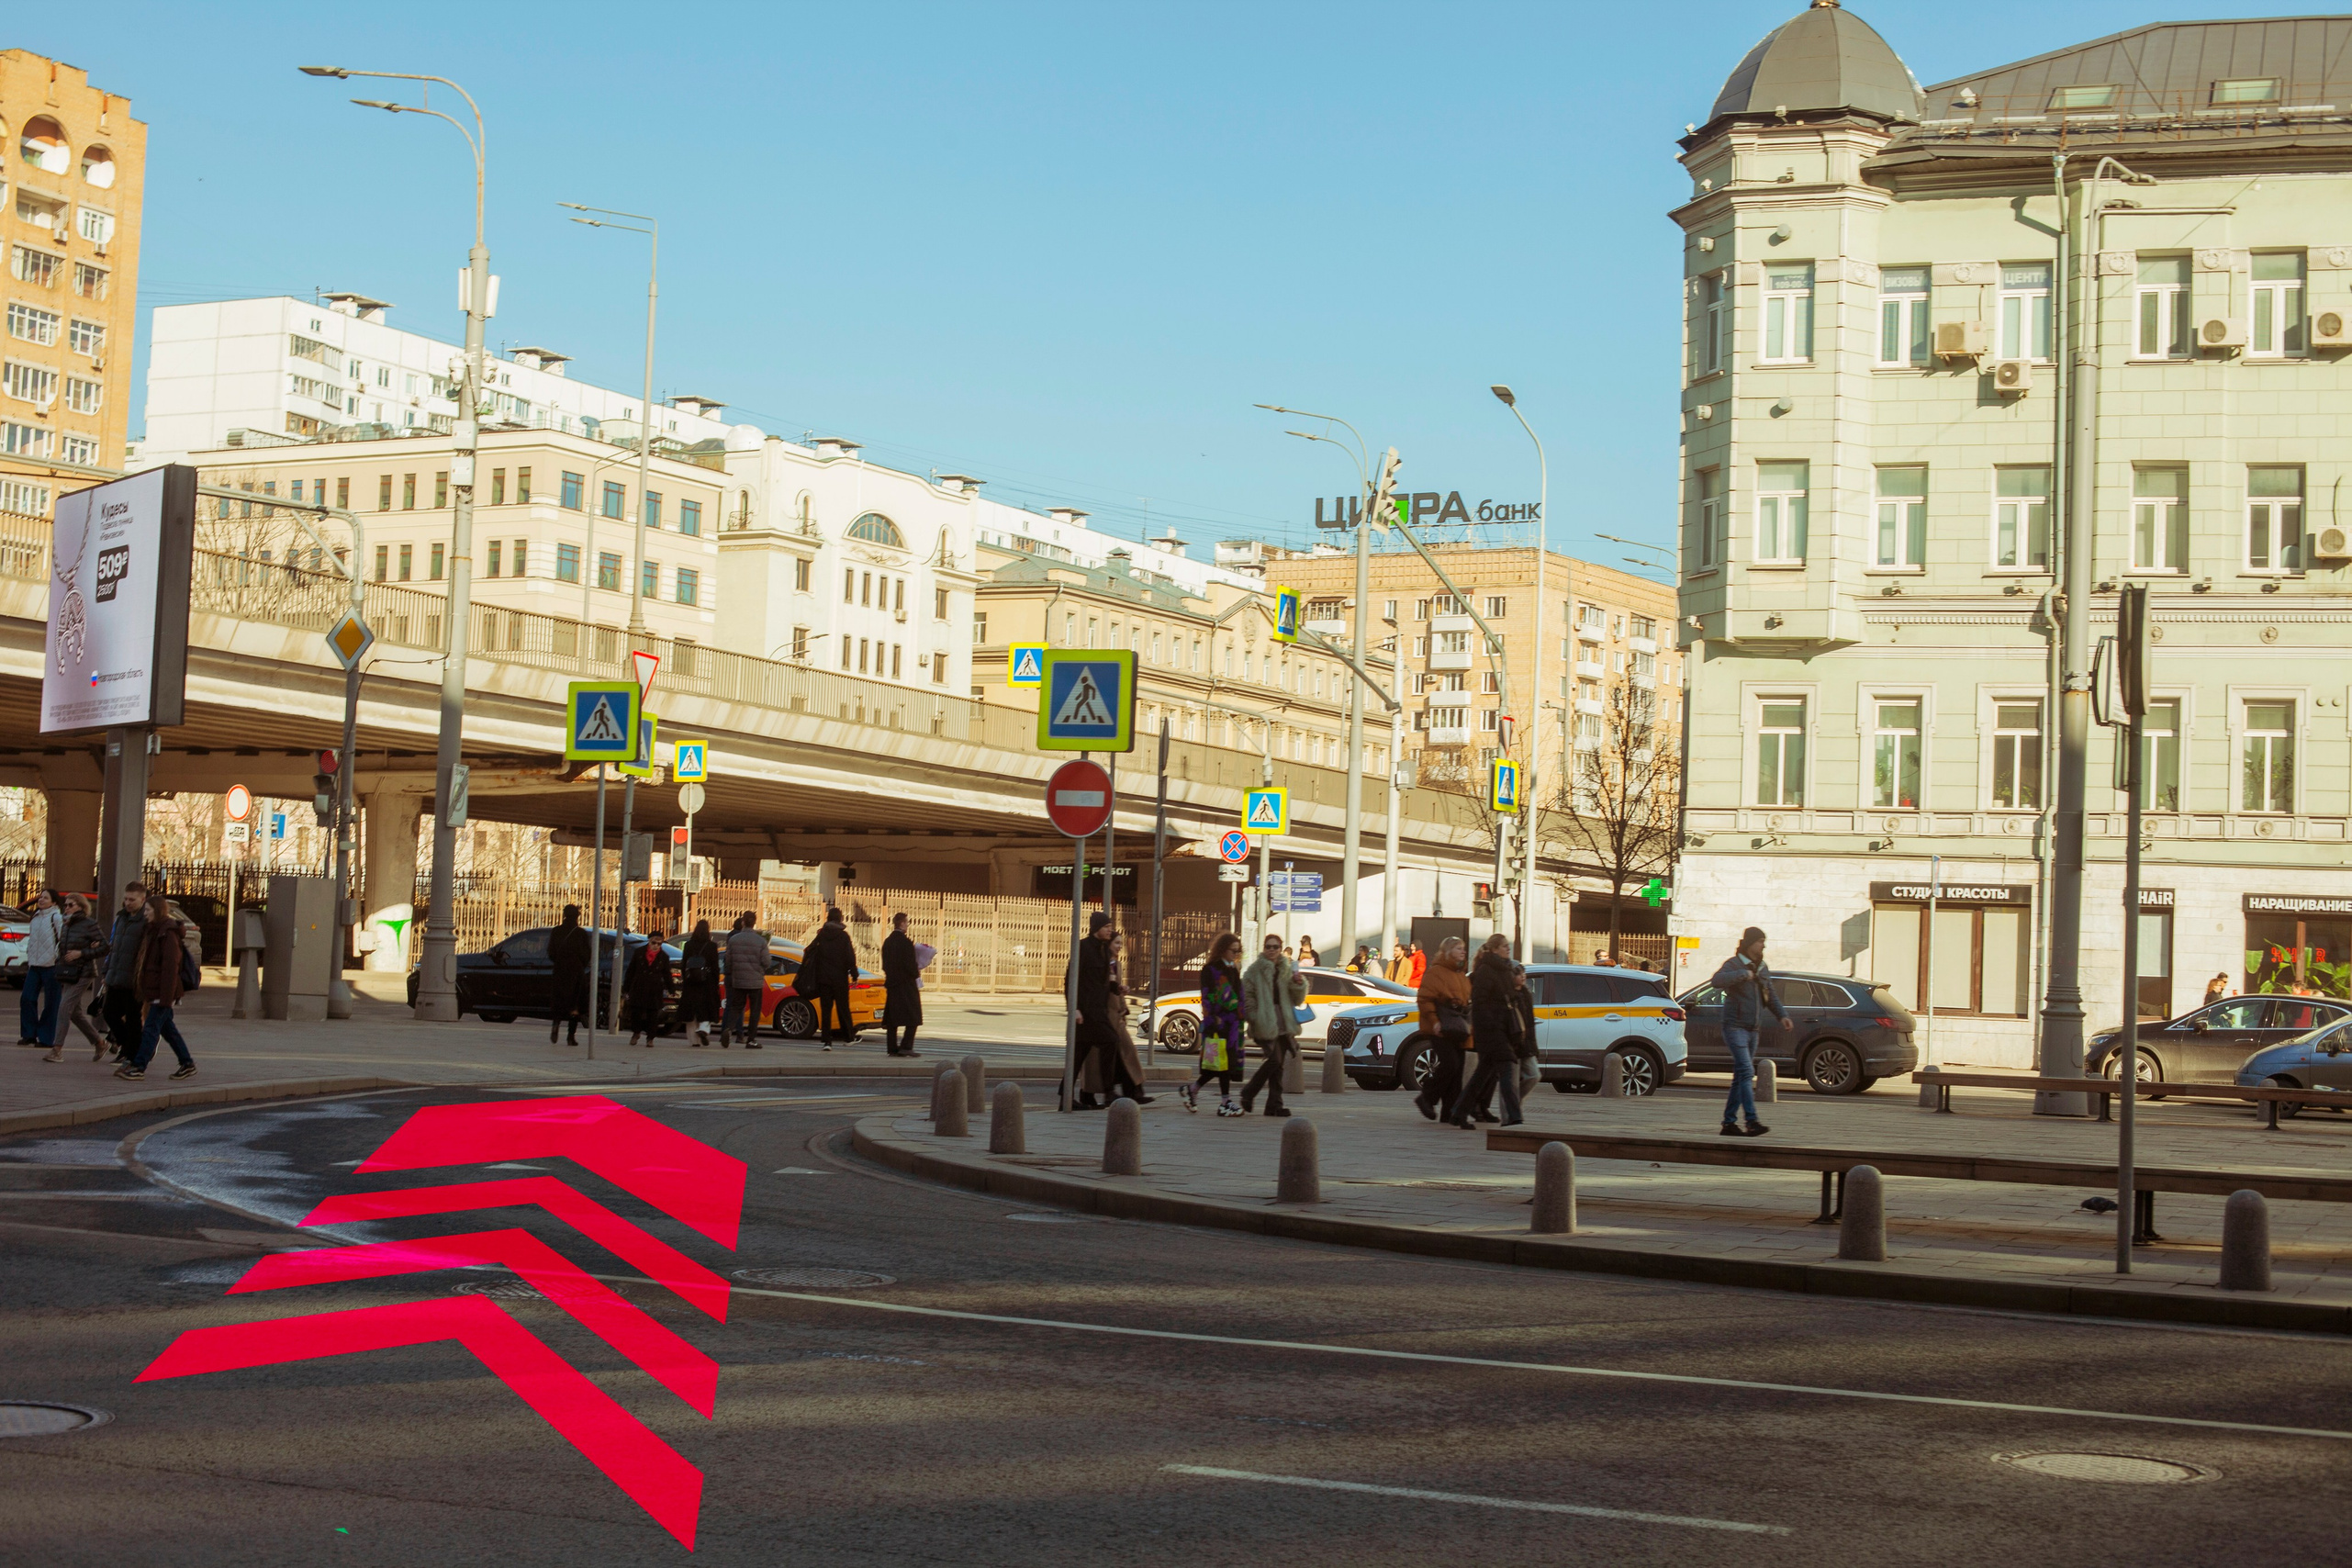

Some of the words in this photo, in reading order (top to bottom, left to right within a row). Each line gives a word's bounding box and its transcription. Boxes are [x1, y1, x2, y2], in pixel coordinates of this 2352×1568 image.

[2005, 272, 2048, 285] ЦЕНТР
[101, 501, 129, 521] Кудесы
[1316, 491, 1471, 532] ЦИРА
[1478, 498, 1541, 521] банк
[1946, 888, 2010, 899] КРАСОТЫ
[2249, 897, 2352, 912] НАРАЩИВАНИЕ
